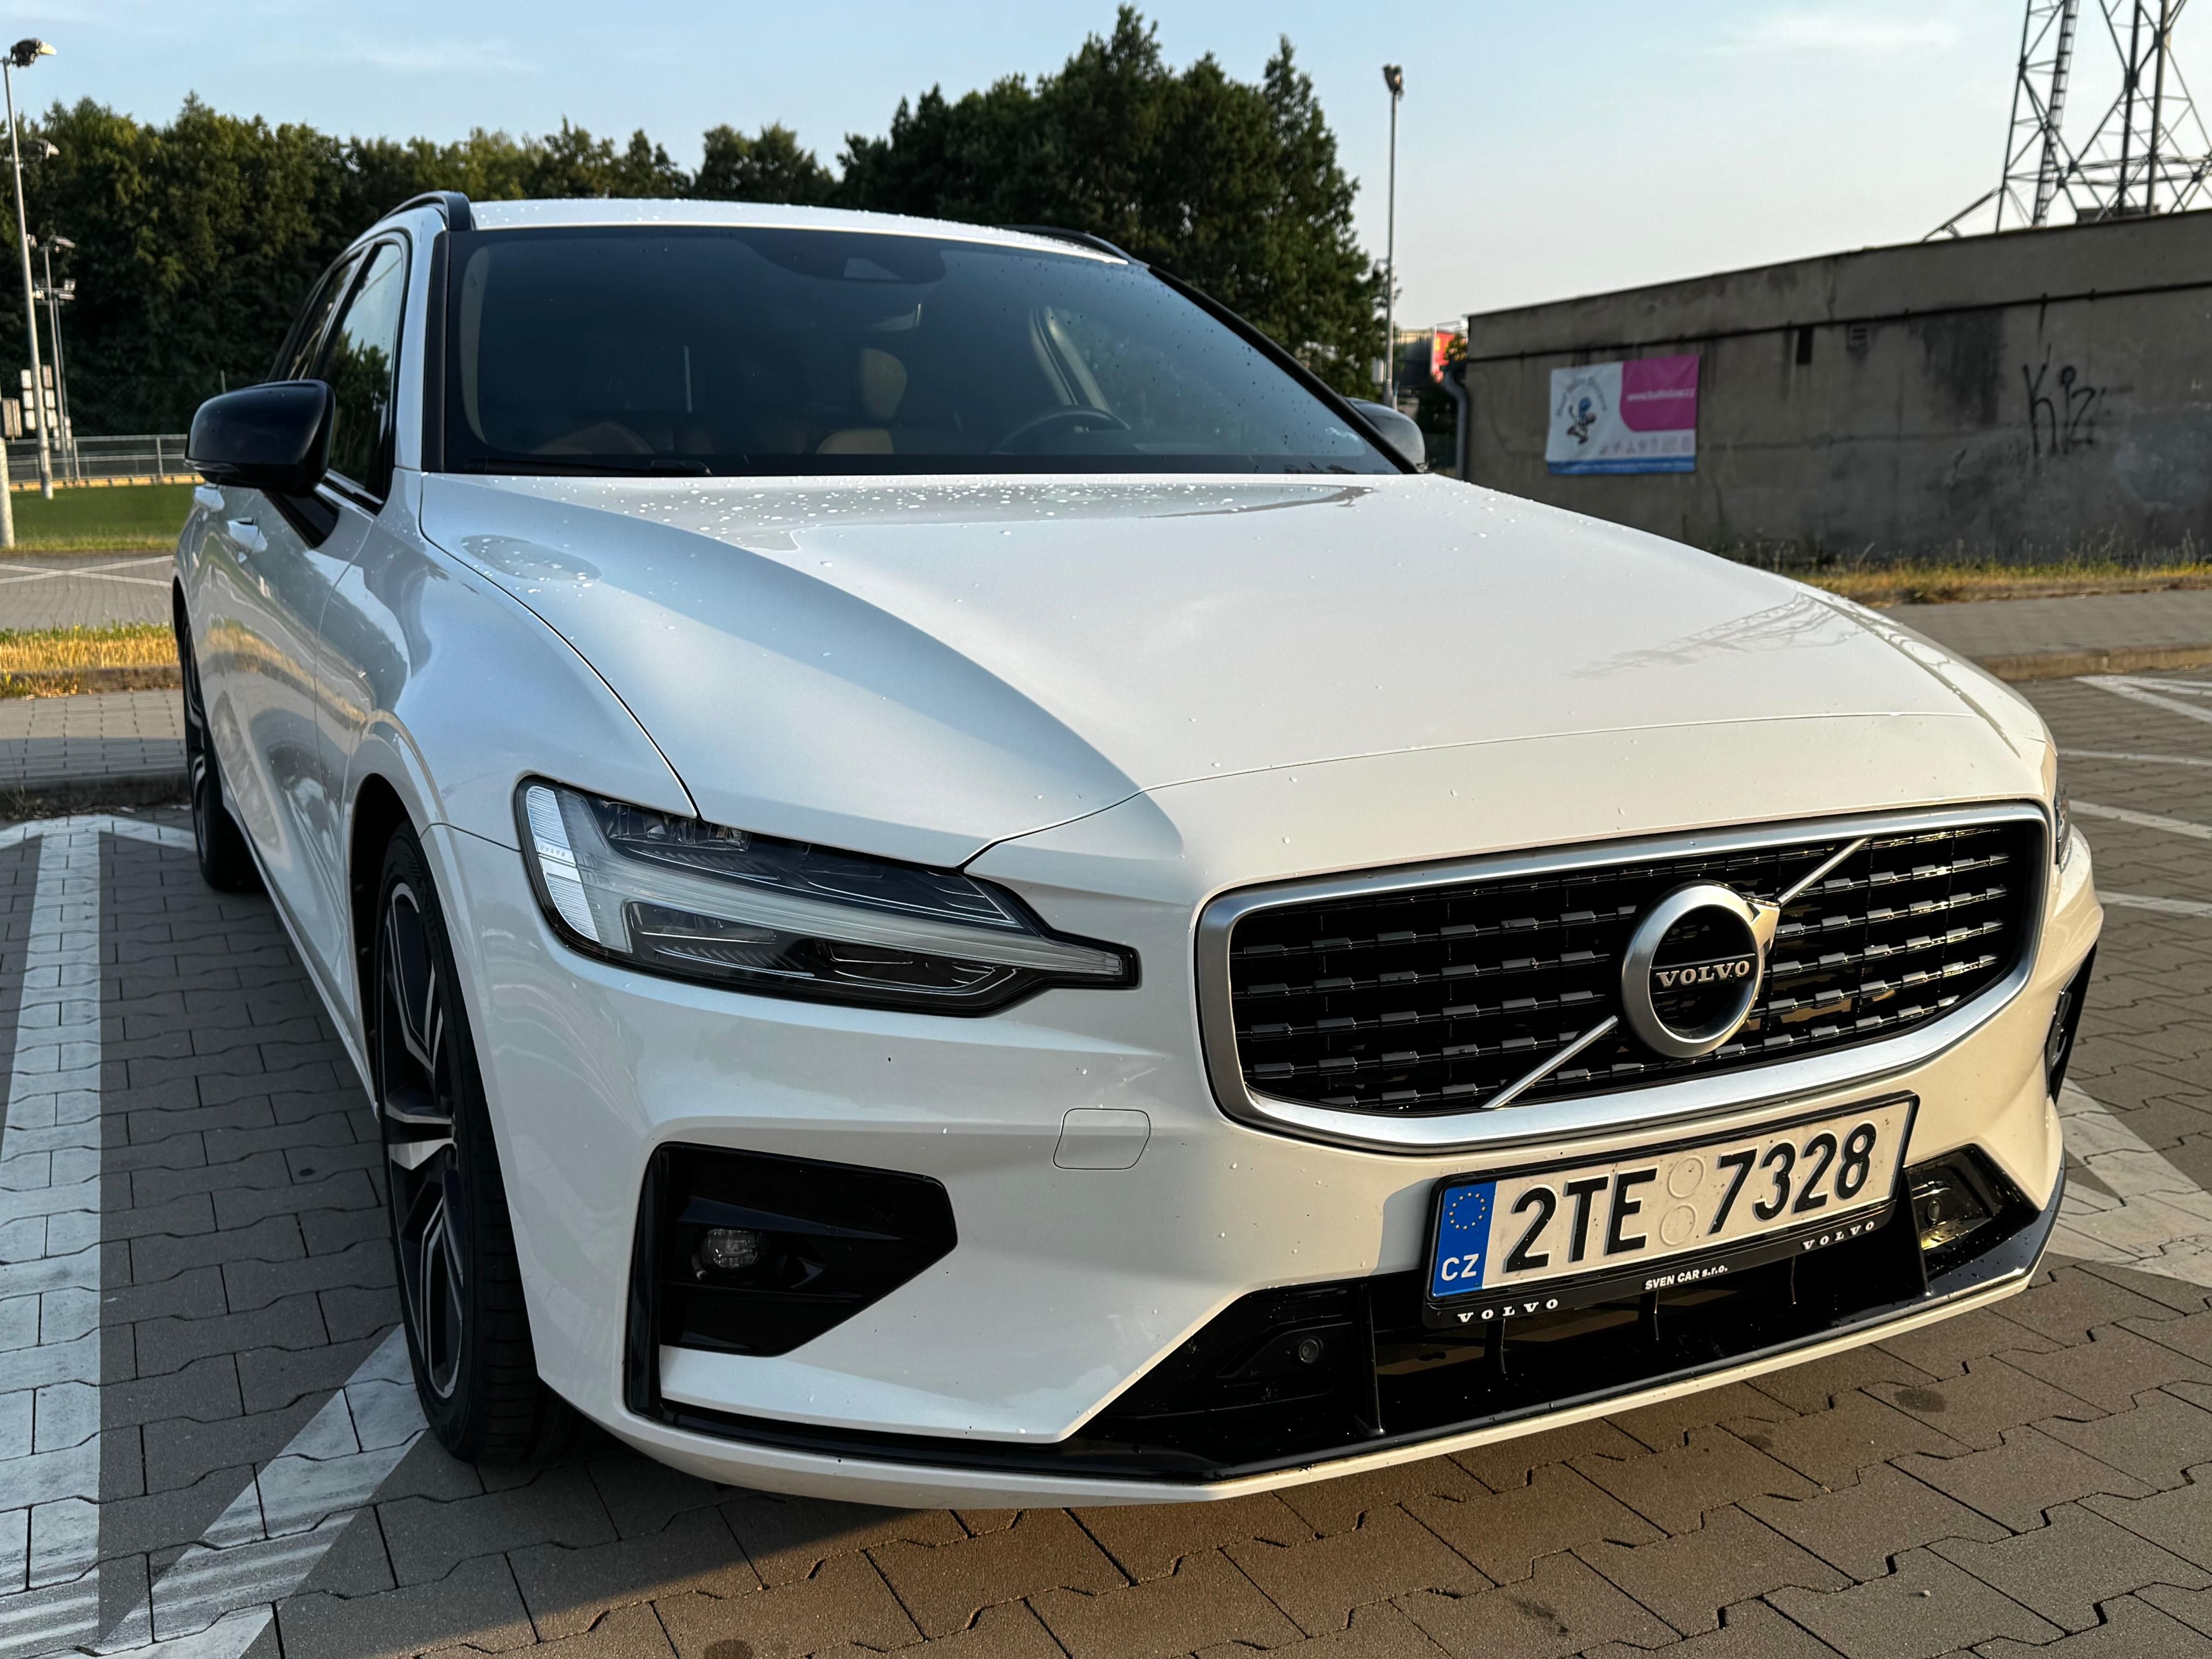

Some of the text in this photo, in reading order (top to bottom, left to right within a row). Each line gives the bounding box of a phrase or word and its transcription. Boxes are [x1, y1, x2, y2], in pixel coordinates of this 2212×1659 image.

[1655, 960, 1750, 988] VOLVO
[1503, 1120, 1877, 1273] 2TE 7328
[1803, 1220, 1874, 1250] VOLVO
[1441, 1253, 1480, 1281] CZ
[1644, 1265, 1728, 1290] SVEN CAR s.r.o.
[1457, 1298, 1559, 1323] VOLVO
